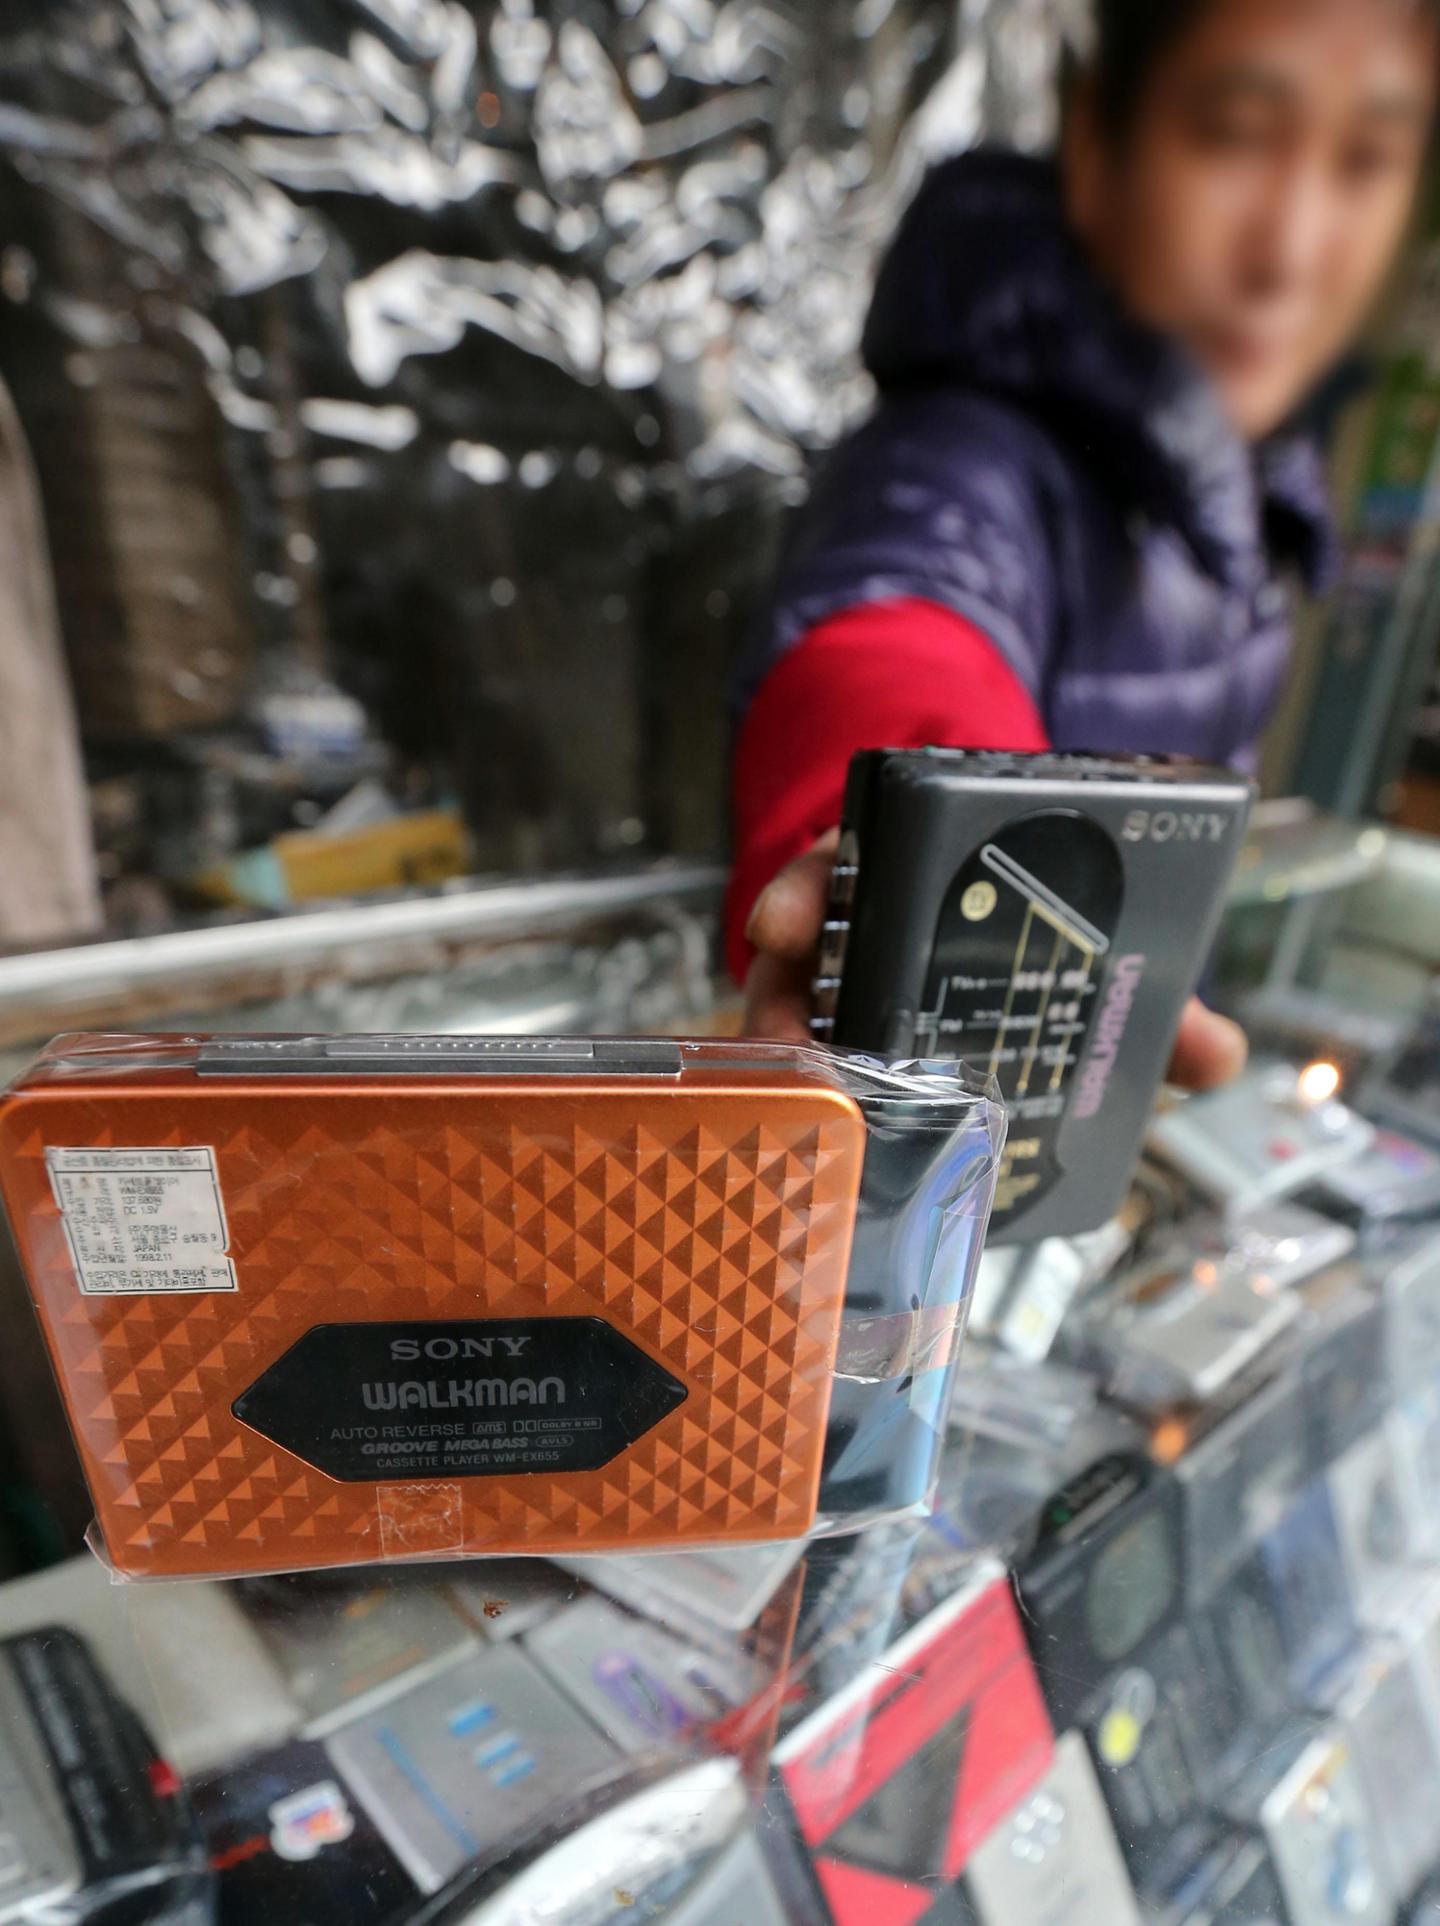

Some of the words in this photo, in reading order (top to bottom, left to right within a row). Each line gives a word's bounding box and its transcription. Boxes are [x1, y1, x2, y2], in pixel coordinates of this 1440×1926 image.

[1121, 809, 1230, 842] SONY
[390, 1336, 532, 1361] SONY
[362, 1376, 566, 1411] WALKMAN
[330, 1425, 378, 1441] AUTO
[382, 1423, 465, 1439] REVERSE
[361, 1439, 438, 1455] GROOVE
[443, 1438, 490, 1452] MEGA
[491, 1436, 529, 1450] BASS
[376, 1454, 438, 1469] CASSETTE
[443, 1452, 490, 1466] PLAYER
[493, 1450, 560, 1464] WM-EX655
